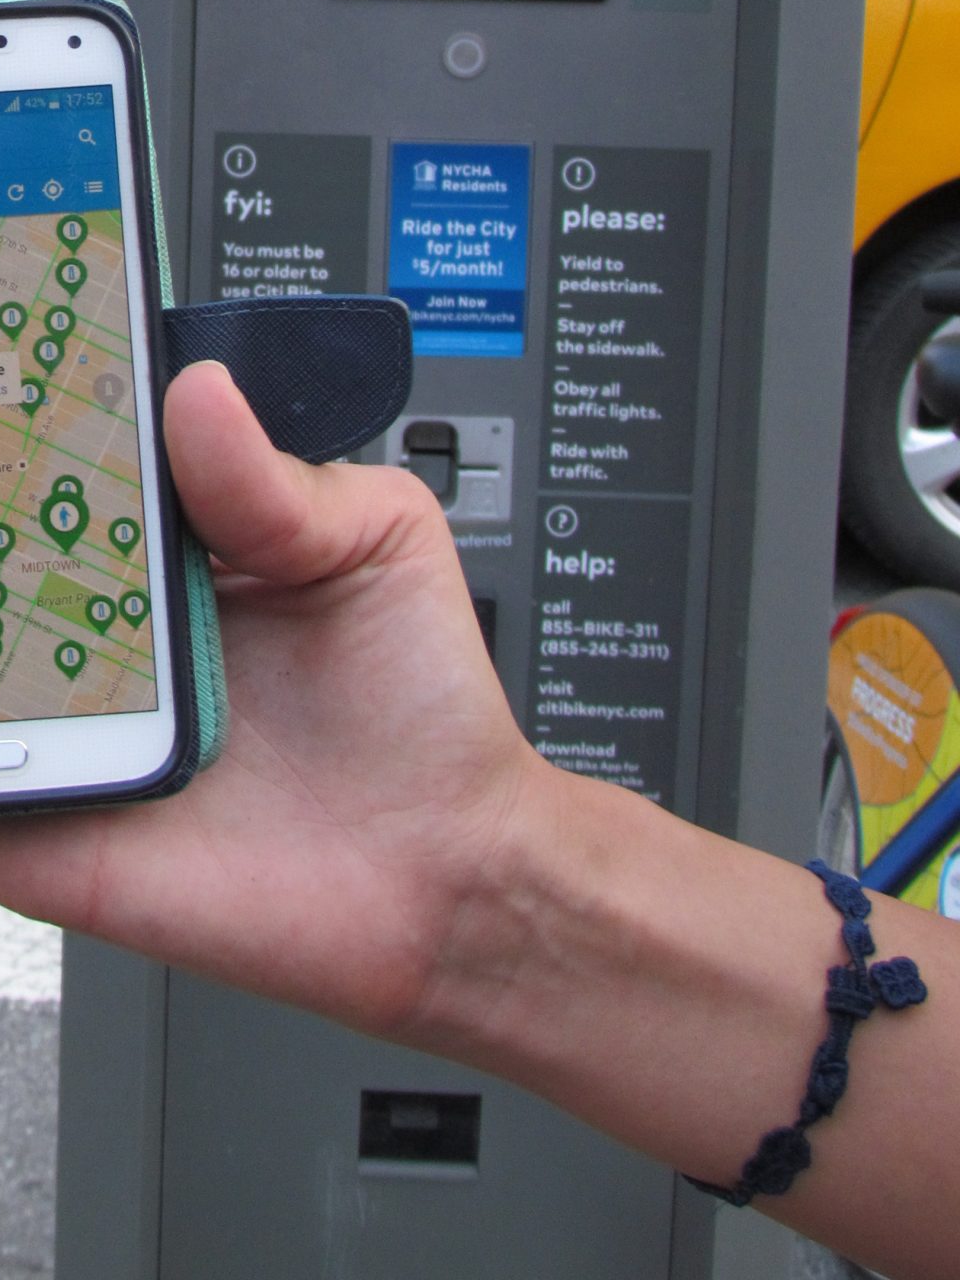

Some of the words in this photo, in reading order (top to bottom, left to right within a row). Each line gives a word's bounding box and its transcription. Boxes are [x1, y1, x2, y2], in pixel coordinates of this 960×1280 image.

[66, 92, 104, 108] 17:52
[442, 164, 492, 177] NYCHA
[442, 179, 508, 193] Residents
[224, 189, 273, 222] fyi:
[562, 203, 666, 235] please:
[401, 219, 442, 236] Ride
[446, 220, 476, 236] the
[480, 221, 517, 240] City
[223, 242, 254, 258] You
[257, 244, 301, 259] must
[304, 244, 325, 259] be
[426, 239, 452, 255] for
[455, 240, 490, 259] just
[222, 263, 240, 278] 16
[243, 267, 260, 278] or
[263, 264, 307, 280] older
[310, 266, 329, 280] to
[412, 257, 504, 277] $5/month!
[560, 255, 602, 271] Yield
[605, 257, 624, 272] to
[222, 286, 250, 298] use
[254, 284, 284, 297] Citi
[558, 276, 663, 294] pedestrians.
[426, 295, 455, 308] Join
[458, 296, 487, 308] Now
[557, 317, 596, 336] Stay
[598, 319, 625, 334] off
[556, 340, 584, 355] the
[587, 340, 665, 357] sidewalk.
[553, 380, 598, 399] Obey
[601, 383, 620, 397] all
[552, 401, 607, 417] traffic
[609, 403, 662, 422] lights.
[550, 442, 588, 458] Ride
[591, 444, 629, 460] with
[549, 464, 608, 480] traffic.
[20, 559, 82, 575] MIDTOWN
[545, 548, 616, 581] help:
[36, 595, 73, 608] Bryant
[542, 599, 571, 615] call
[538, 681, 574, 696] visit
[537, 701, 665, 720] citibikenyc.com
[536, 740, 616, 758] download
